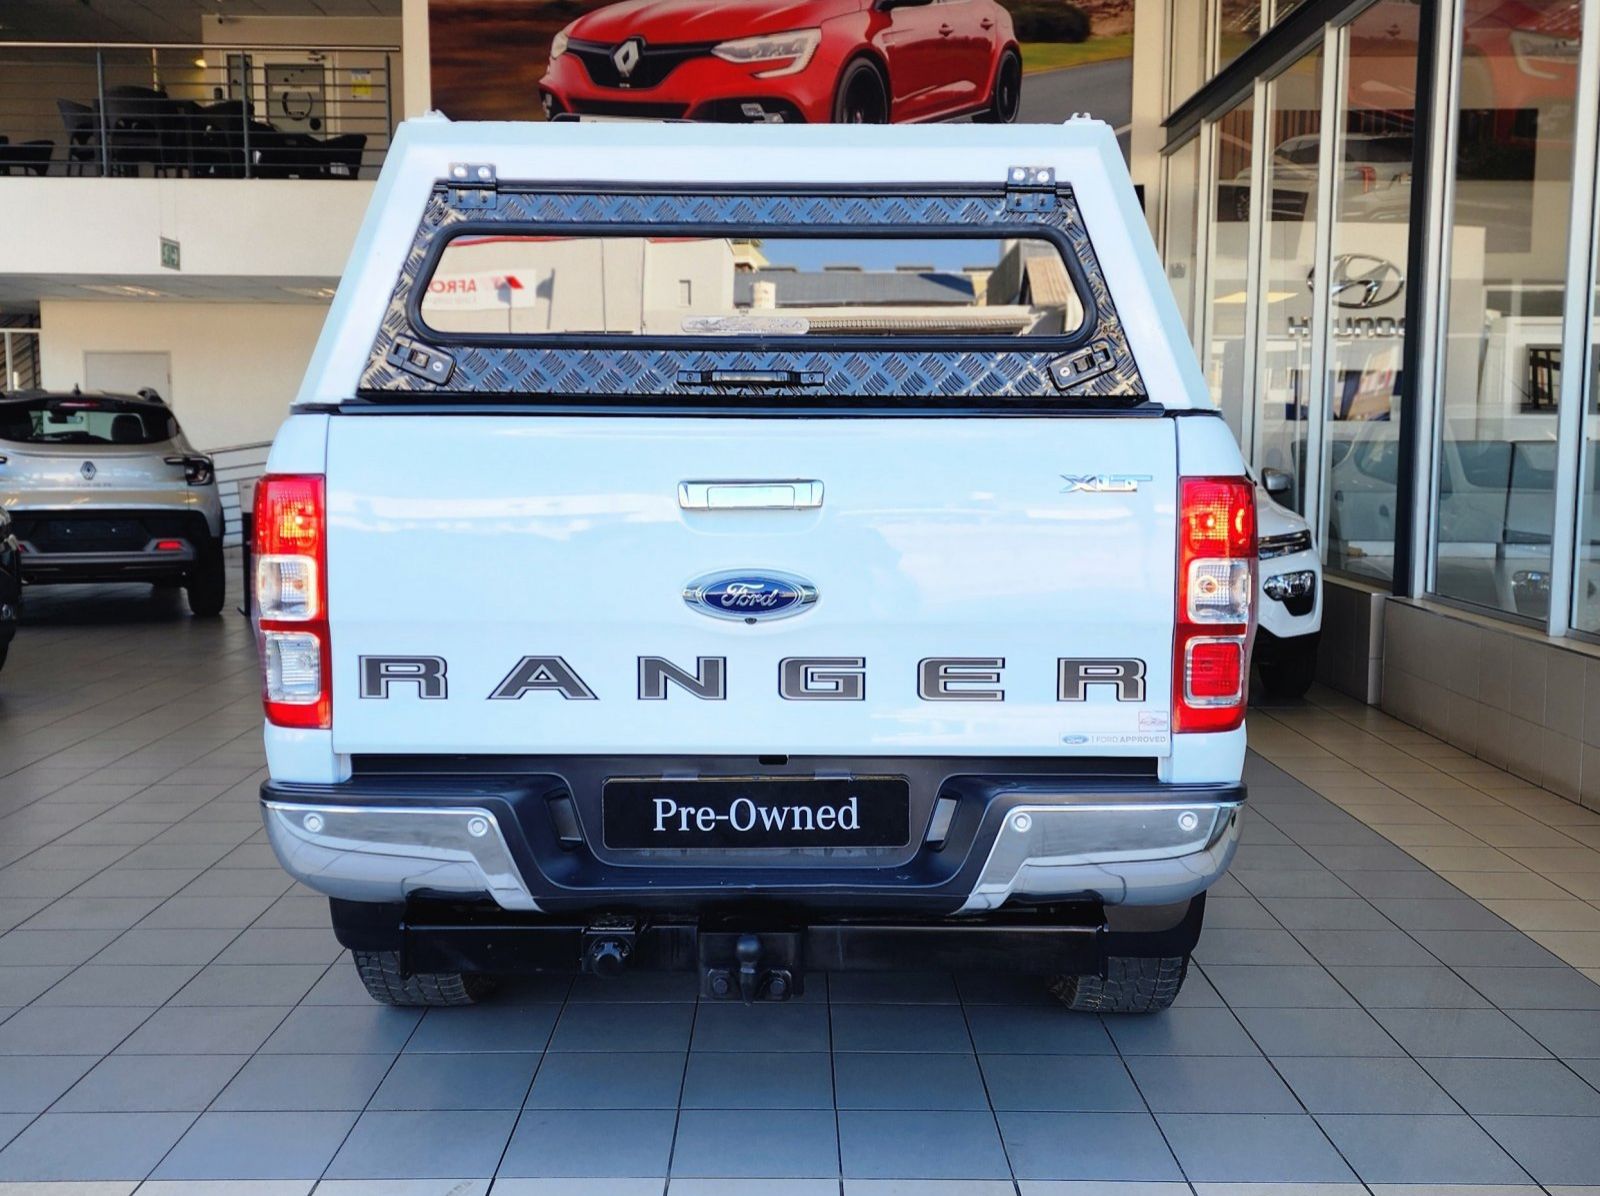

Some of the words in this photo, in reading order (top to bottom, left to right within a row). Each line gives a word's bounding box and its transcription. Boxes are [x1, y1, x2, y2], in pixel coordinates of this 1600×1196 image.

[1059, 474, 1153, 493] XLT
[720, 582, 779, 607] Ford
[358, 654, 1147, 702] RANGER
[1119, 735, 1166, 743] APPROVED
[652, 797, 860, 832] Pre-Owned
